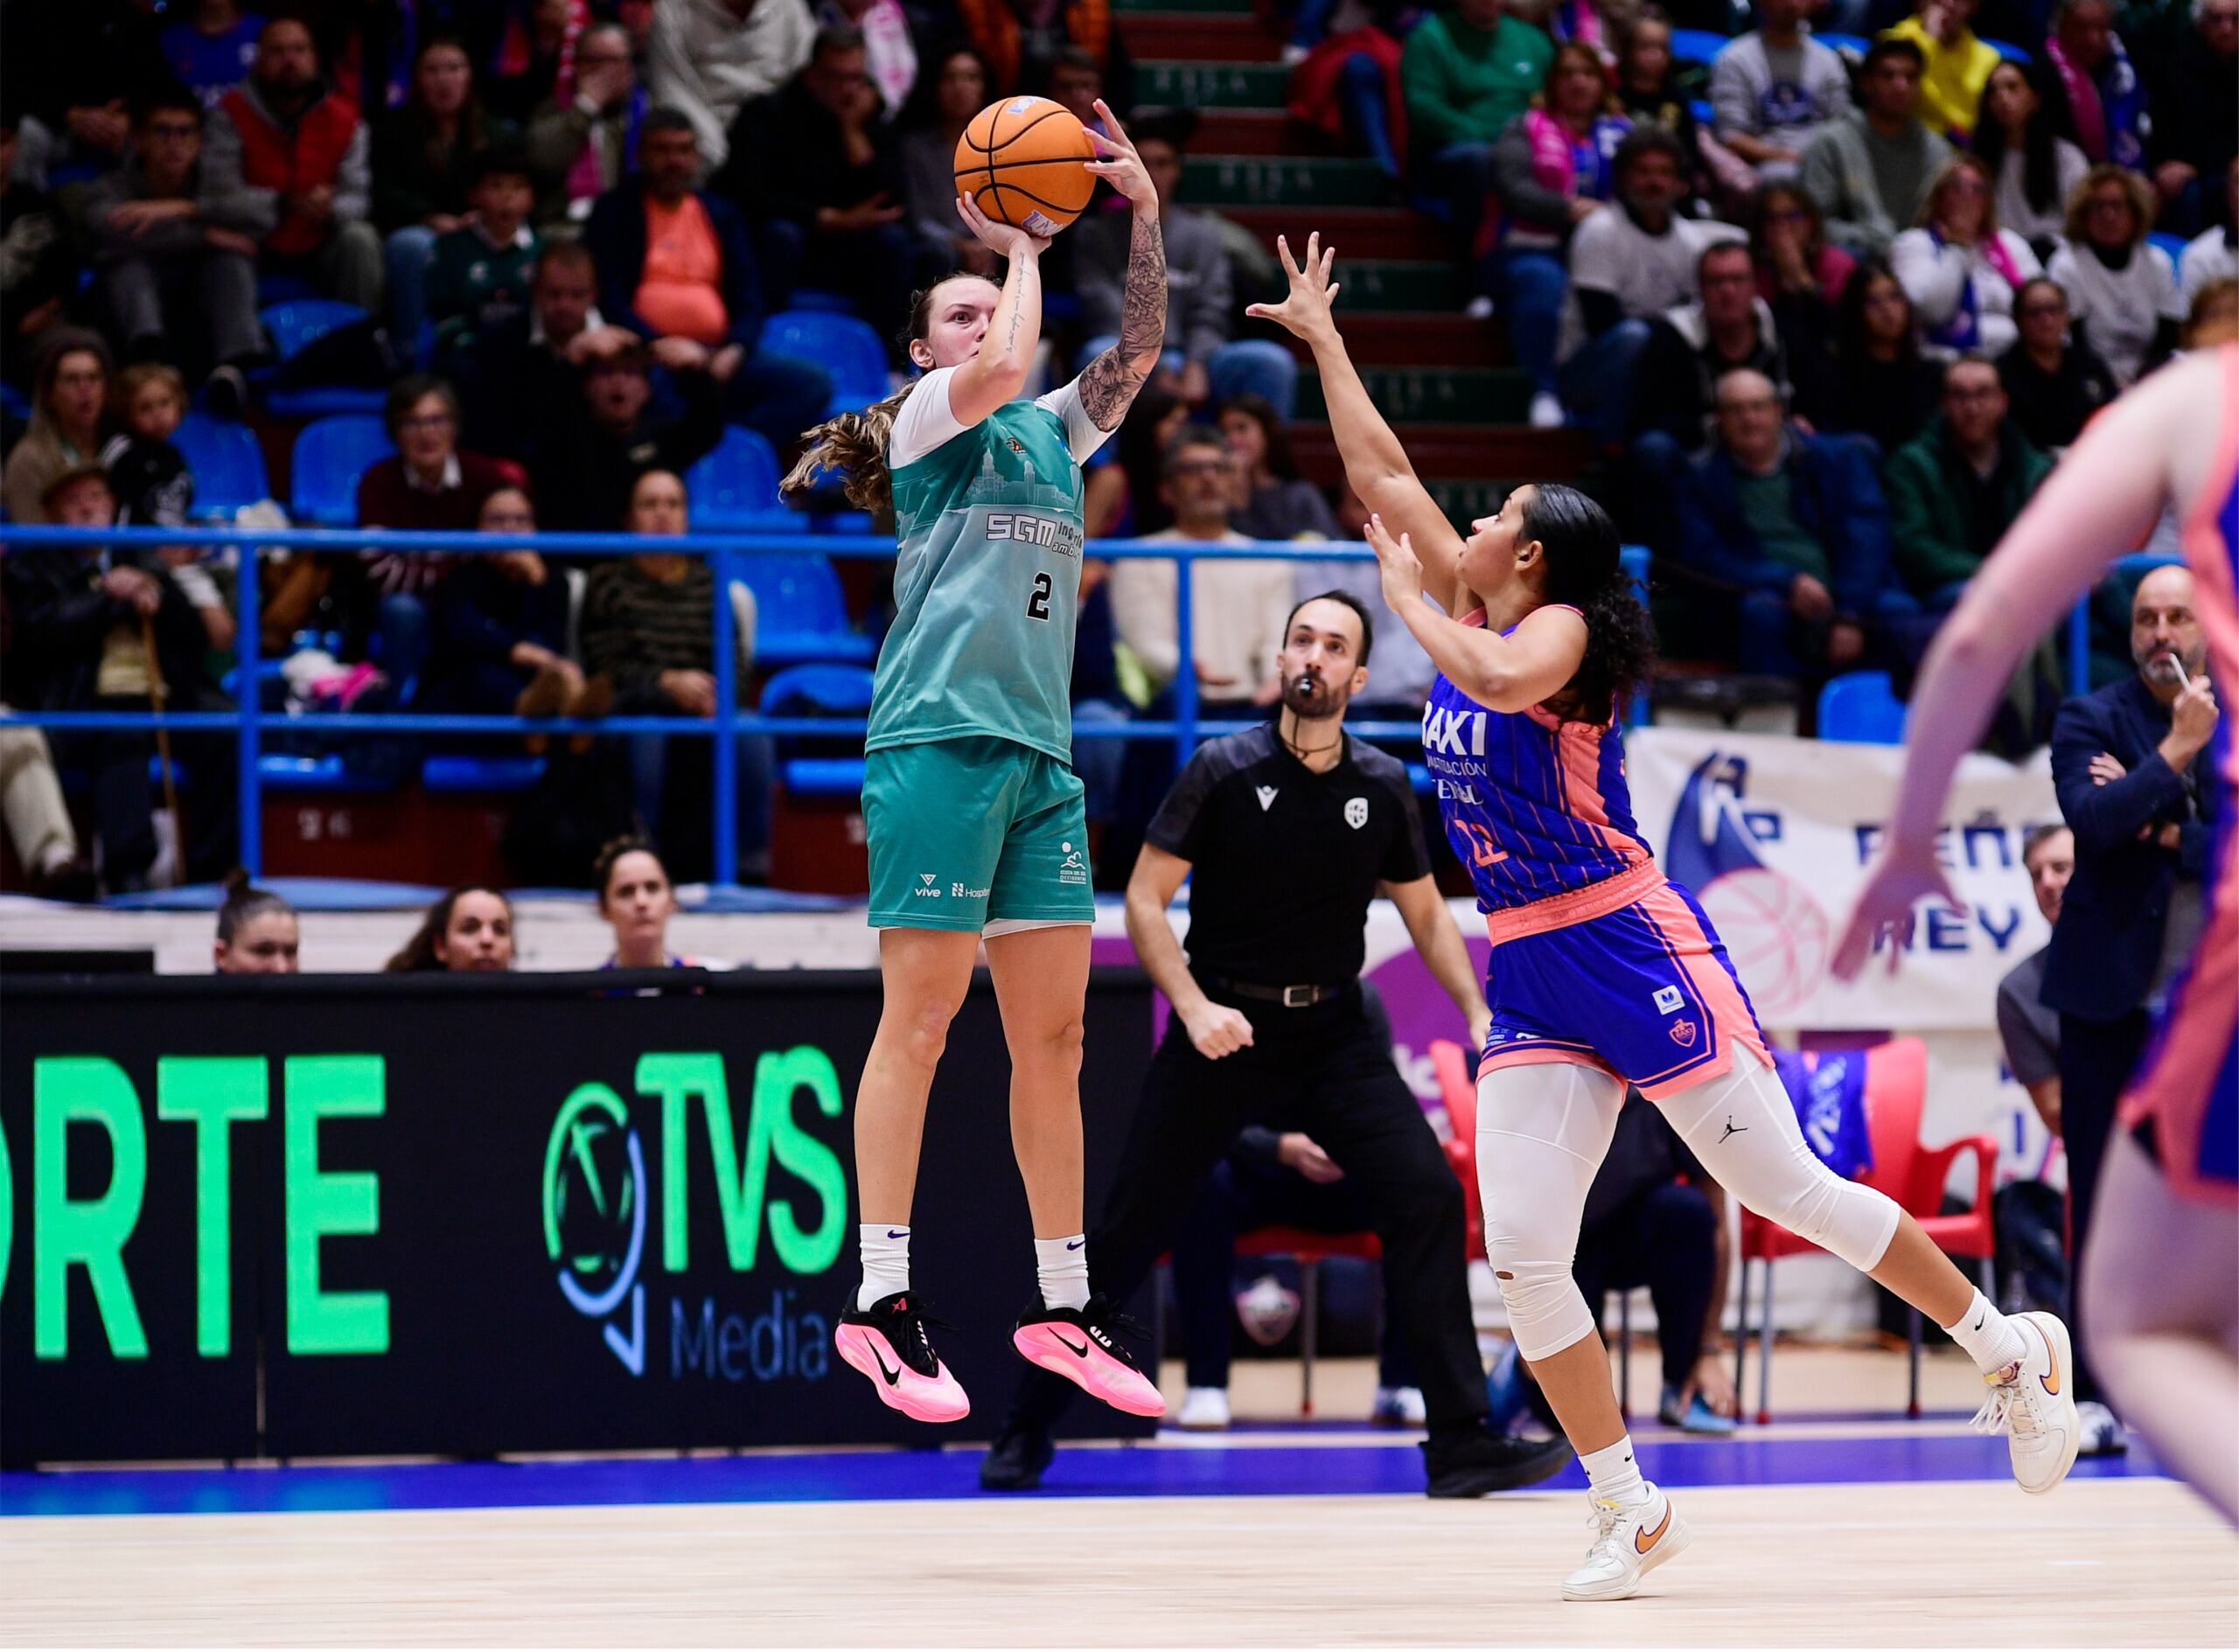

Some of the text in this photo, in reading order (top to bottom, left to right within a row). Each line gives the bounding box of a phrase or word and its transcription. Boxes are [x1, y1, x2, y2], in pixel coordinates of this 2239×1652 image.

[987, 513, 1057, 547] SGM
[1026, 571, 1052, 622] 2
[915, 887, 941, 897] vive
[635, 1045, 847, 1273] TVS
[0, 1056, 390, 1360] RTE
[671, 1287, 829, 1381] Media
